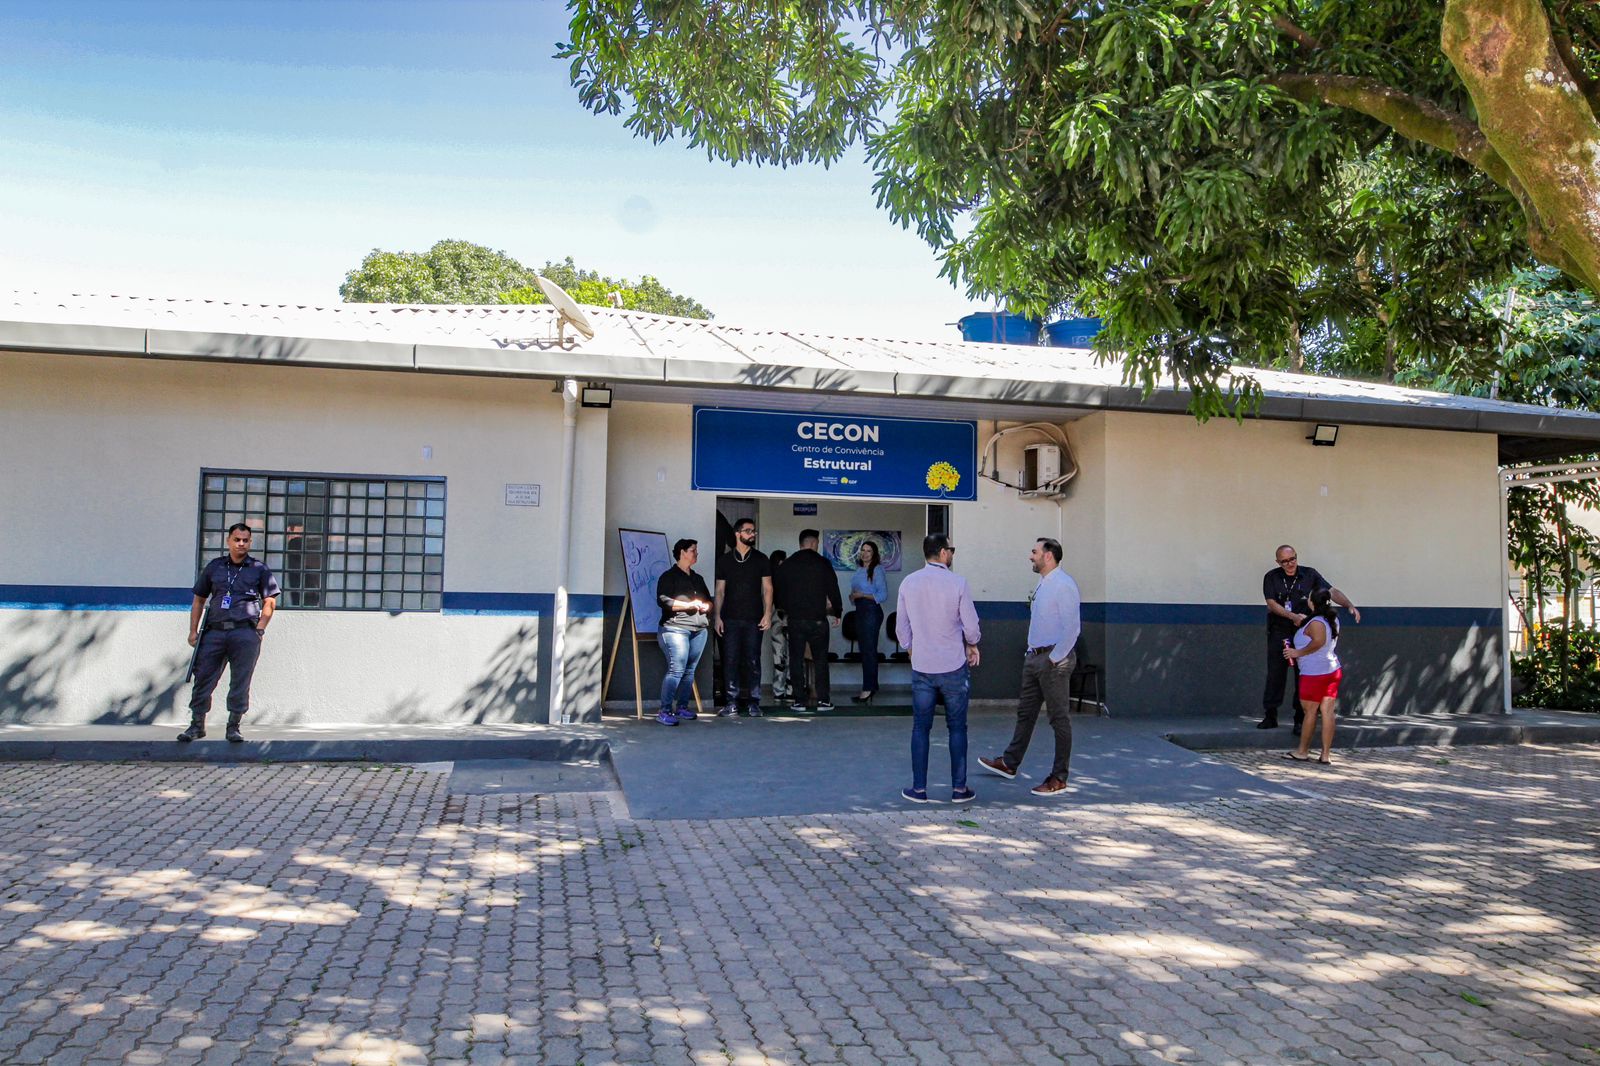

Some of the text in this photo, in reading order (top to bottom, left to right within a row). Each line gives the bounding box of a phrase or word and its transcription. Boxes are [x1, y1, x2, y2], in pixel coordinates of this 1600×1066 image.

[797, 421, 879, 442] CECON
[791, 444, 885, 456] Centro de Convivência
[803, 457, 872, 471] Estrutural
